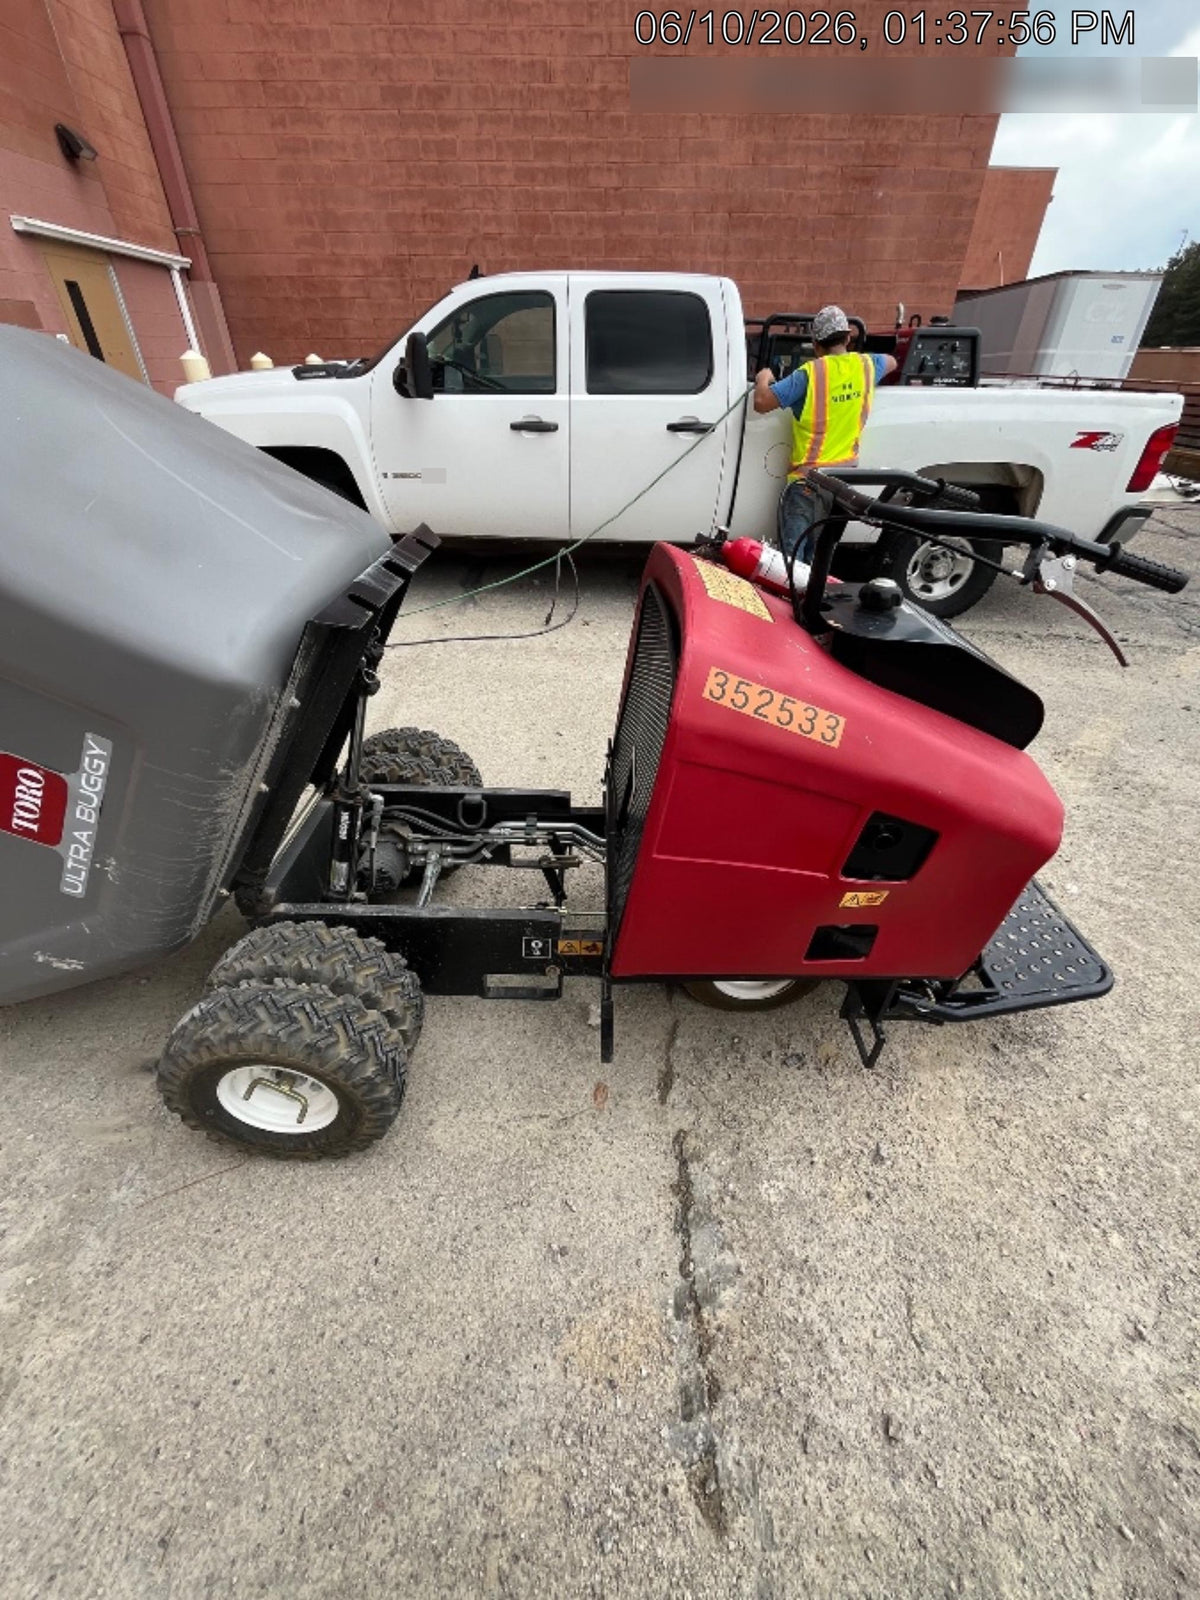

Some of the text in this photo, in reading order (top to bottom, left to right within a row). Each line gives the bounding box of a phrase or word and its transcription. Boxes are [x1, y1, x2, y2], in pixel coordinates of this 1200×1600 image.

[709, 672, 839, 743] 352533
[12, 768, 45, 832] TORO
[64, 739, 107, 894] ULTRA BUGGY
